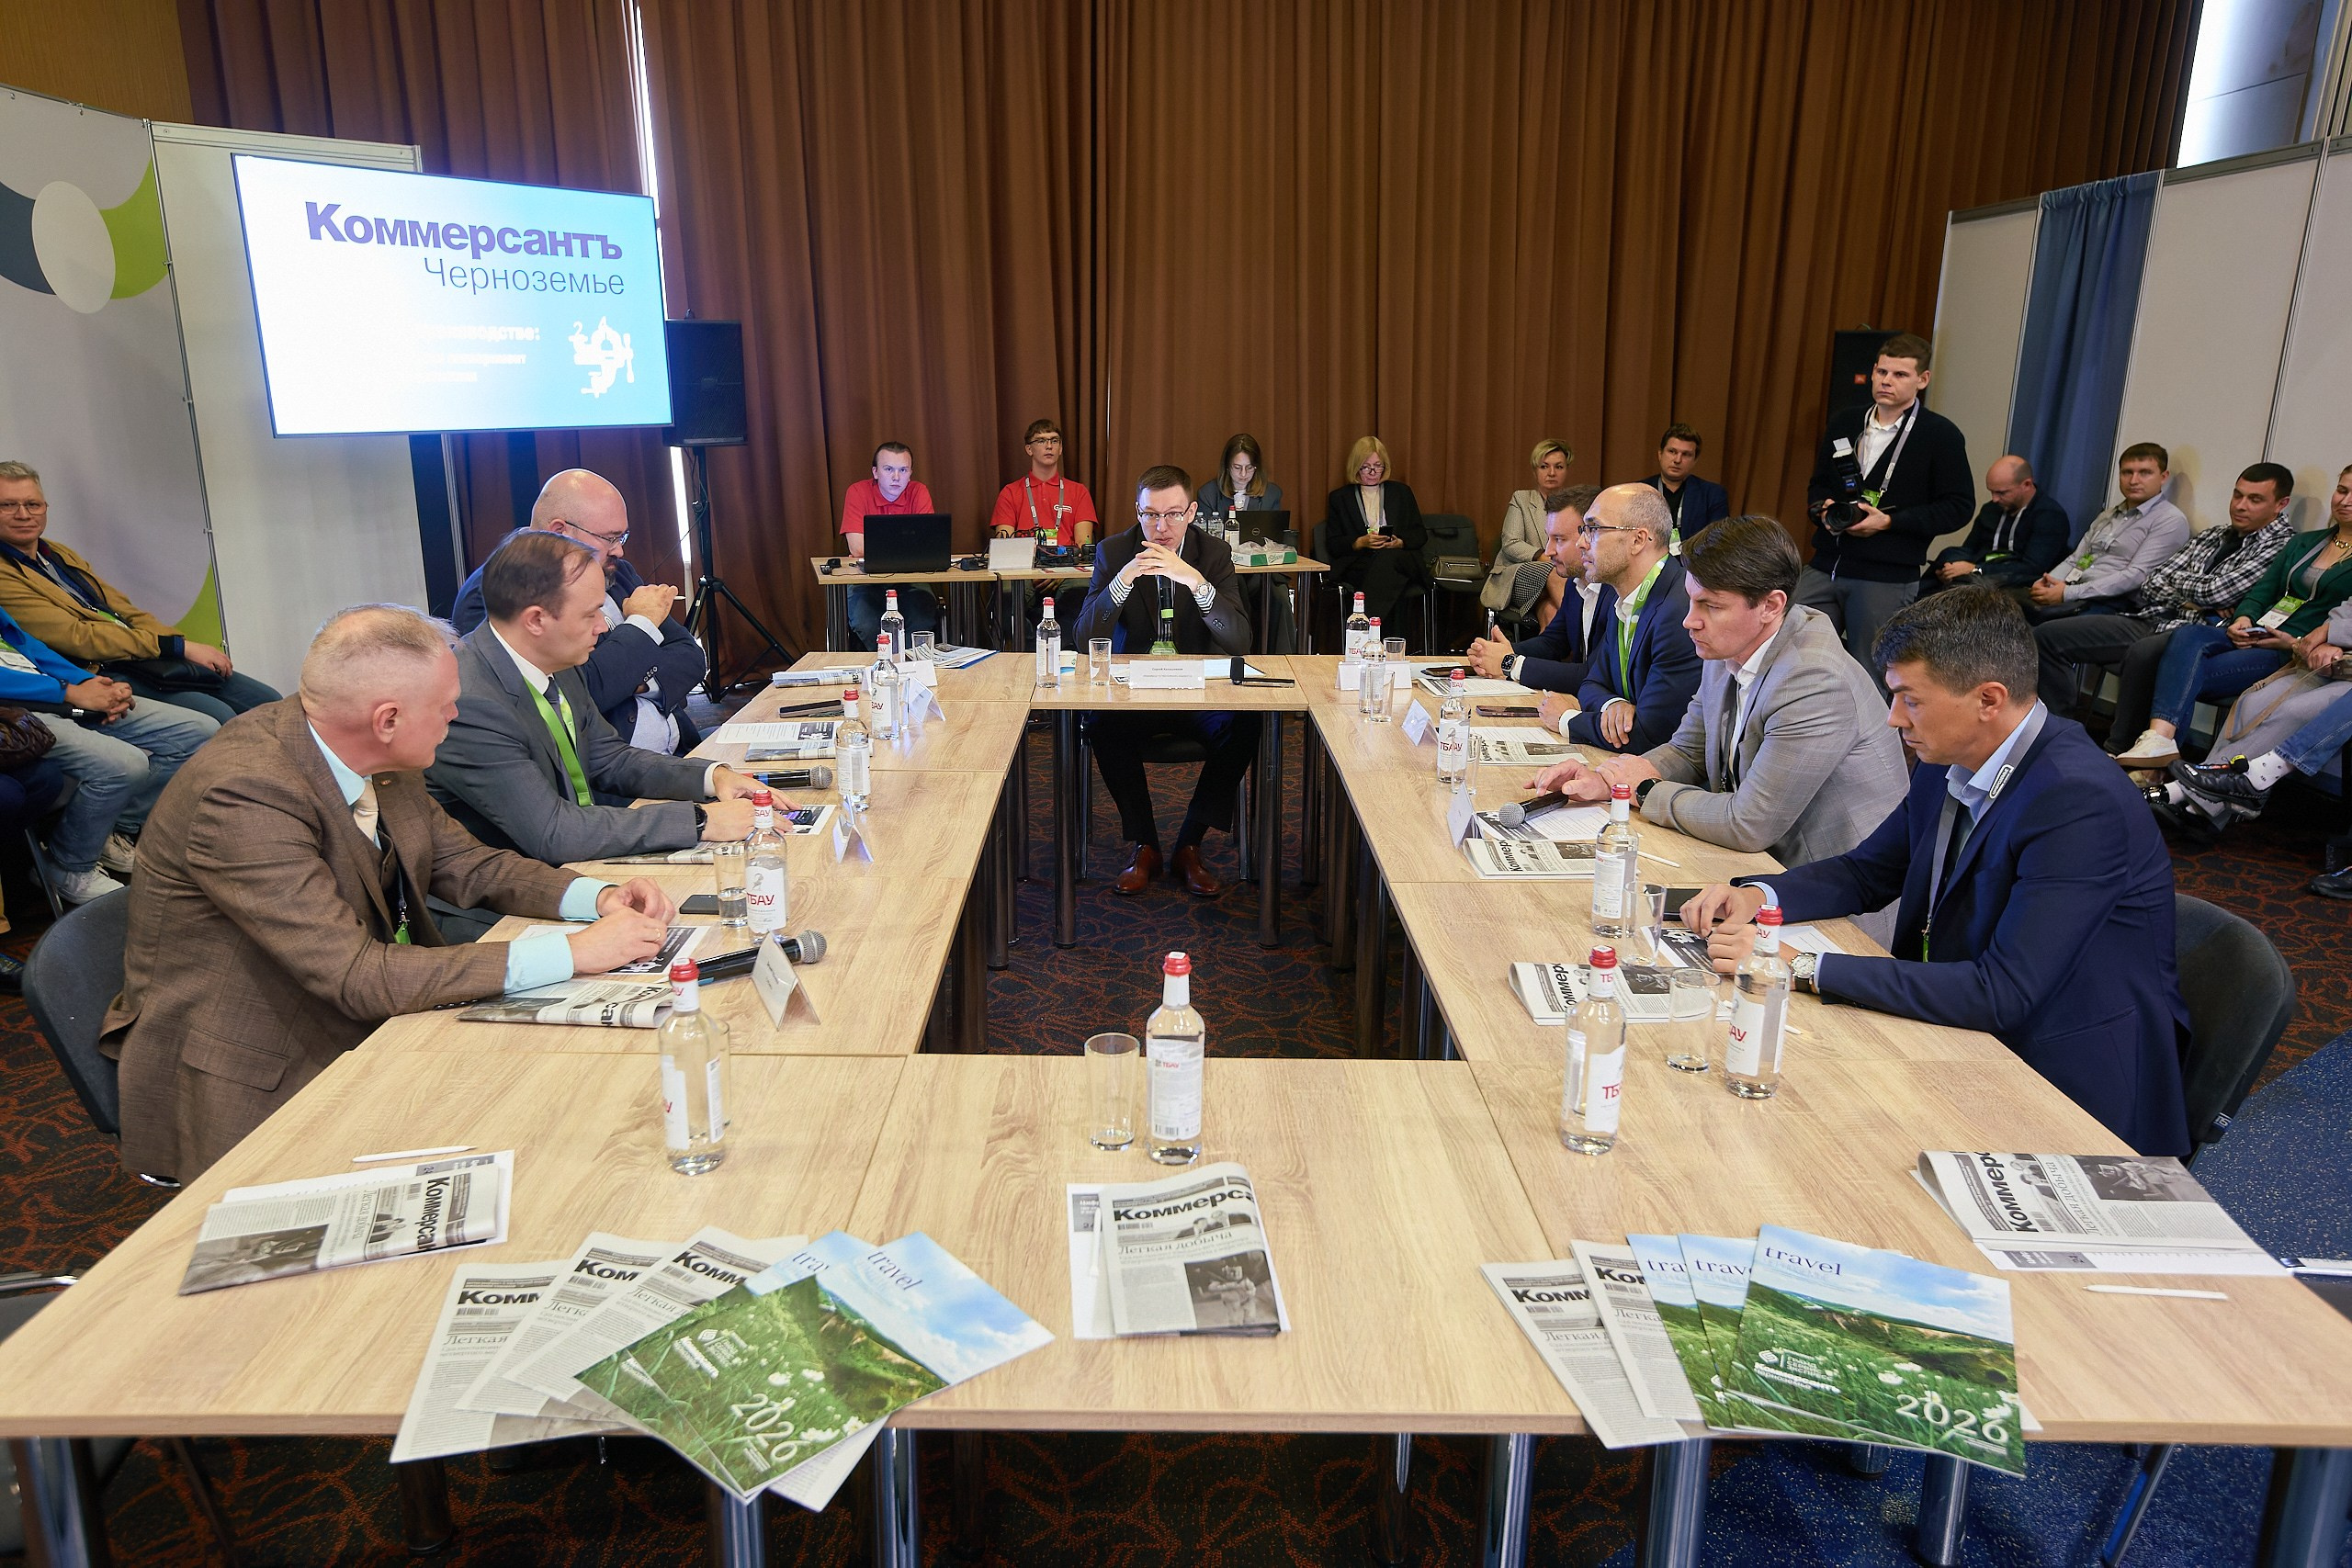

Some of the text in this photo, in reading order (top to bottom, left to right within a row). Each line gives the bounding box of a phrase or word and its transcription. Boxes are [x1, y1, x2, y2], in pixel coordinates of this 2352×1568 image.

[305, 201, 623, 260] Коммерсантъ
[424, 257, 625, 295] Черноземье
[2045, 1161, 2077, 1205] добыча
[2069, 1202, 2104, 1235] Легкая
[1118, 1242, 1172, 1255] Легкая
[1175, 1231, 1234, 1250] добыча
[574, 1259, 643, 1281] Ком
[867, 1250, 923, 1291] travel
[1646, 1258, 1688, 1274] tra
[1695, 1258, 1752, 1276] trav
[1763, 1246, 1843, 1276] travel
[443, 1335, 508, 1346] Легкая
[1545, 1332, 1600, 1342] Легкая
[730, 1393, 811, 1463] 2026
[1894, 1393, 2010, 1444] 2026
